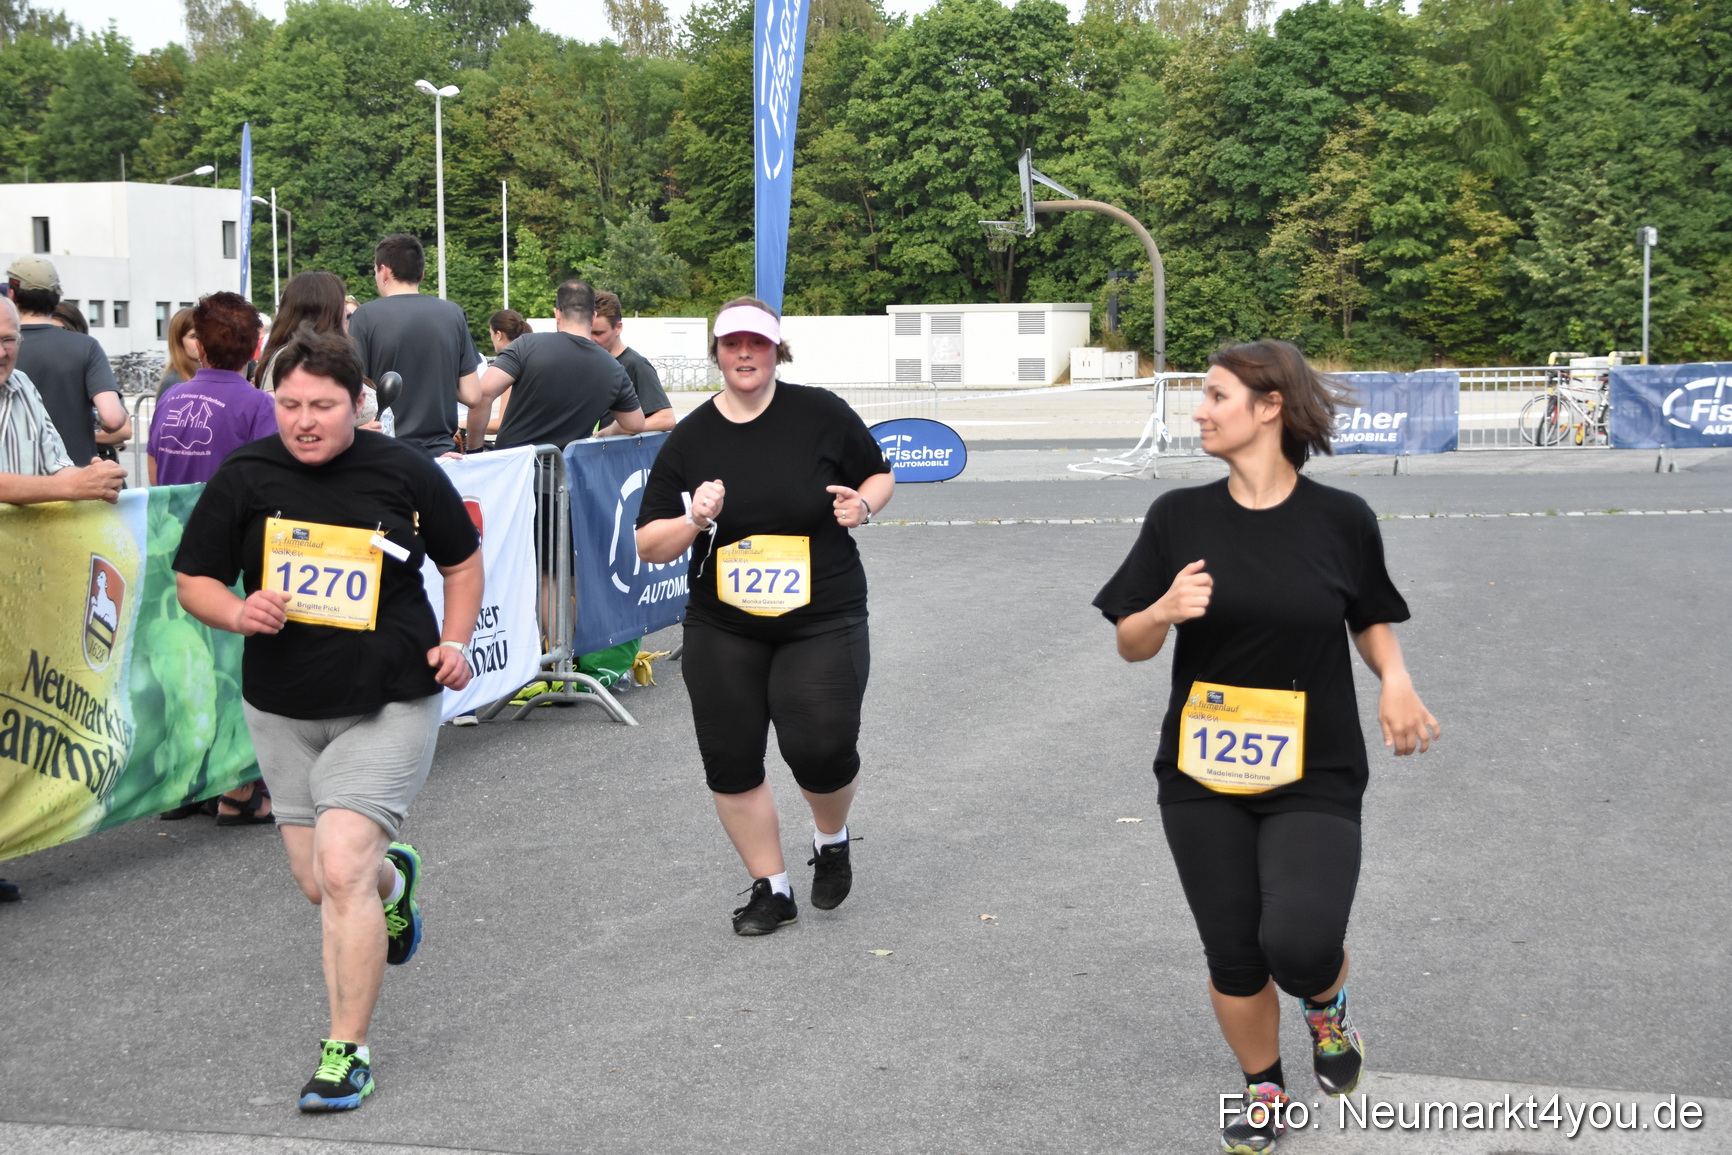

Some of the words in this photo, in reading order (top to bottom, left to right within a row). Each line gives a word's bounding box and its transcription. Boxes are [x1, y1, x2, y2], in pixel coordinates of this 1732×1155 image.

[887, 446, 953, 460] Fischer
[893, 460, 949, 468] AUTOMOBILE
[271, 547, 304, 558] walken
[276, 561, 368, 602] 1270
[728, 568, 800, 594] 1272
[297, 601, 322, 611] Brigitte
[89, 639, 107, 663] 1628
[1187, 711, 1219, 723] walken
[1193, 727, 1289, 767] 1257
[1206, 768, 1243, 779] Madeleine
